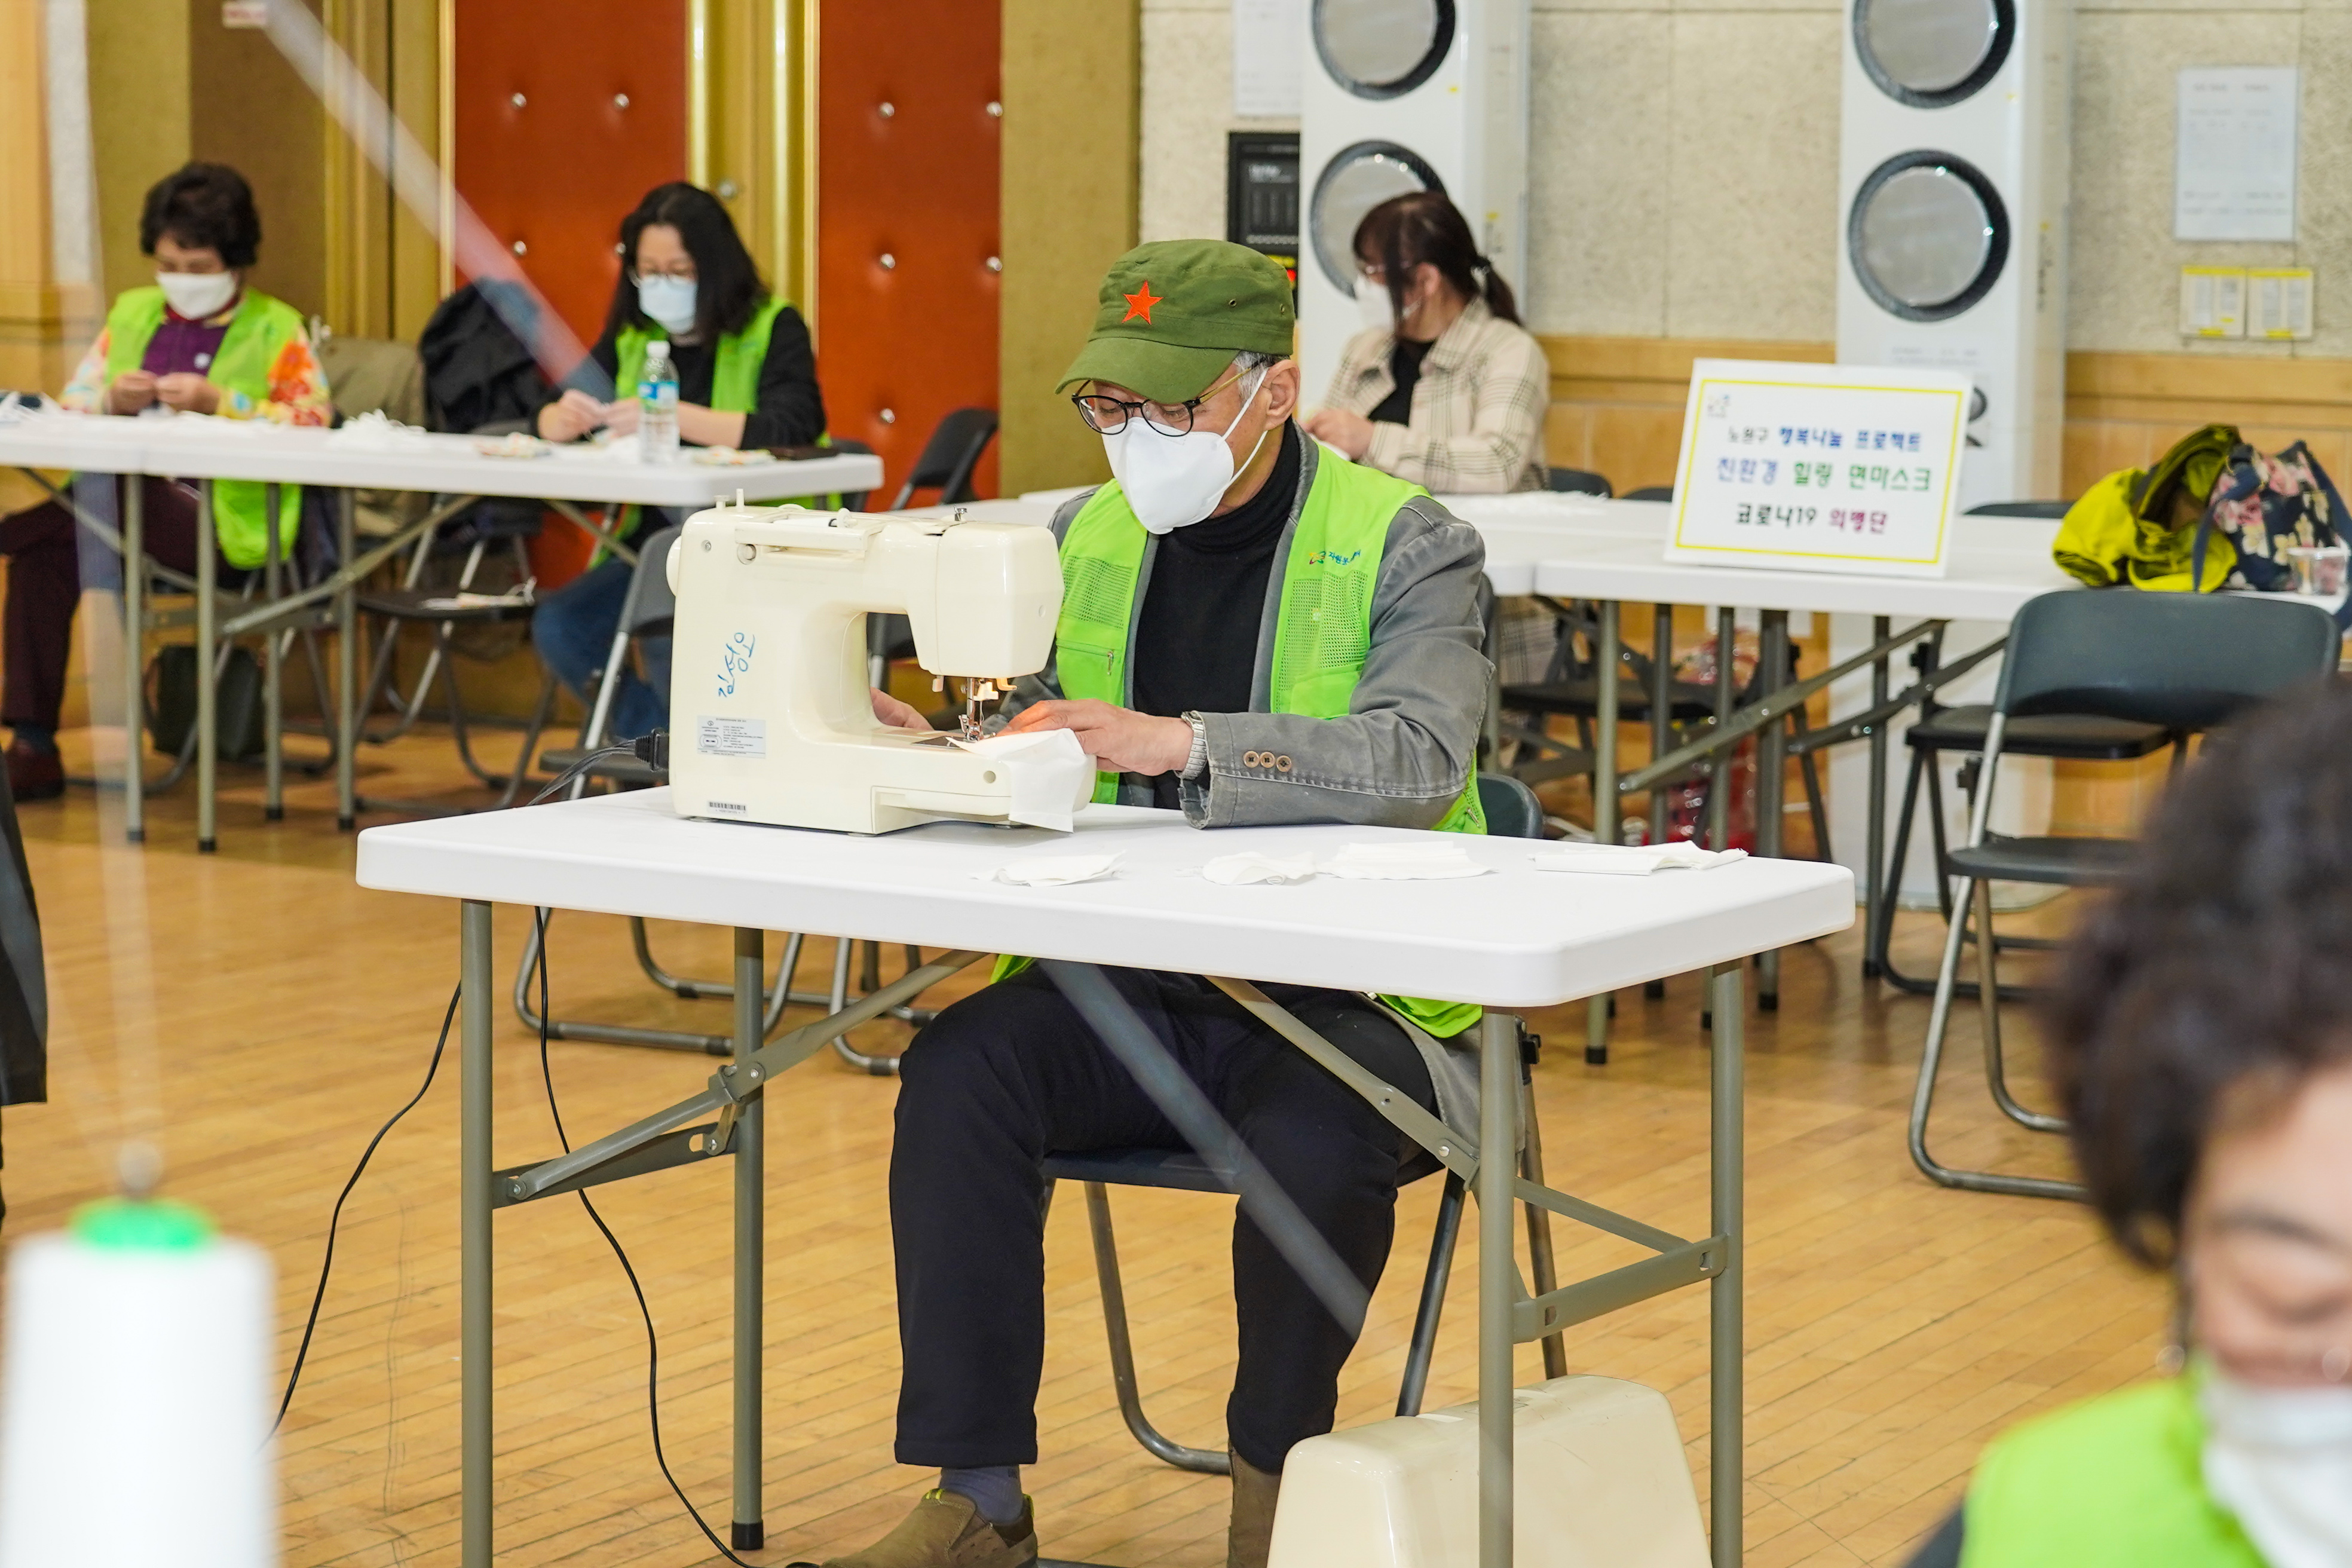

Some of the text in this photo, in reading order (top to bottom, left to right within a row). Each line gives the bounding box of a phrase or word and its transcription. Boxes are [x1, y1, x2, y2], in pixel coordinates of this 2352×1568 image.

[1855, 430, 1920, 452] 프로젝트
[1718, 458, 1931, 492] 친환경 힐링 면마스크
[1736, 503, 1888, 534] 코로나19 의병단
